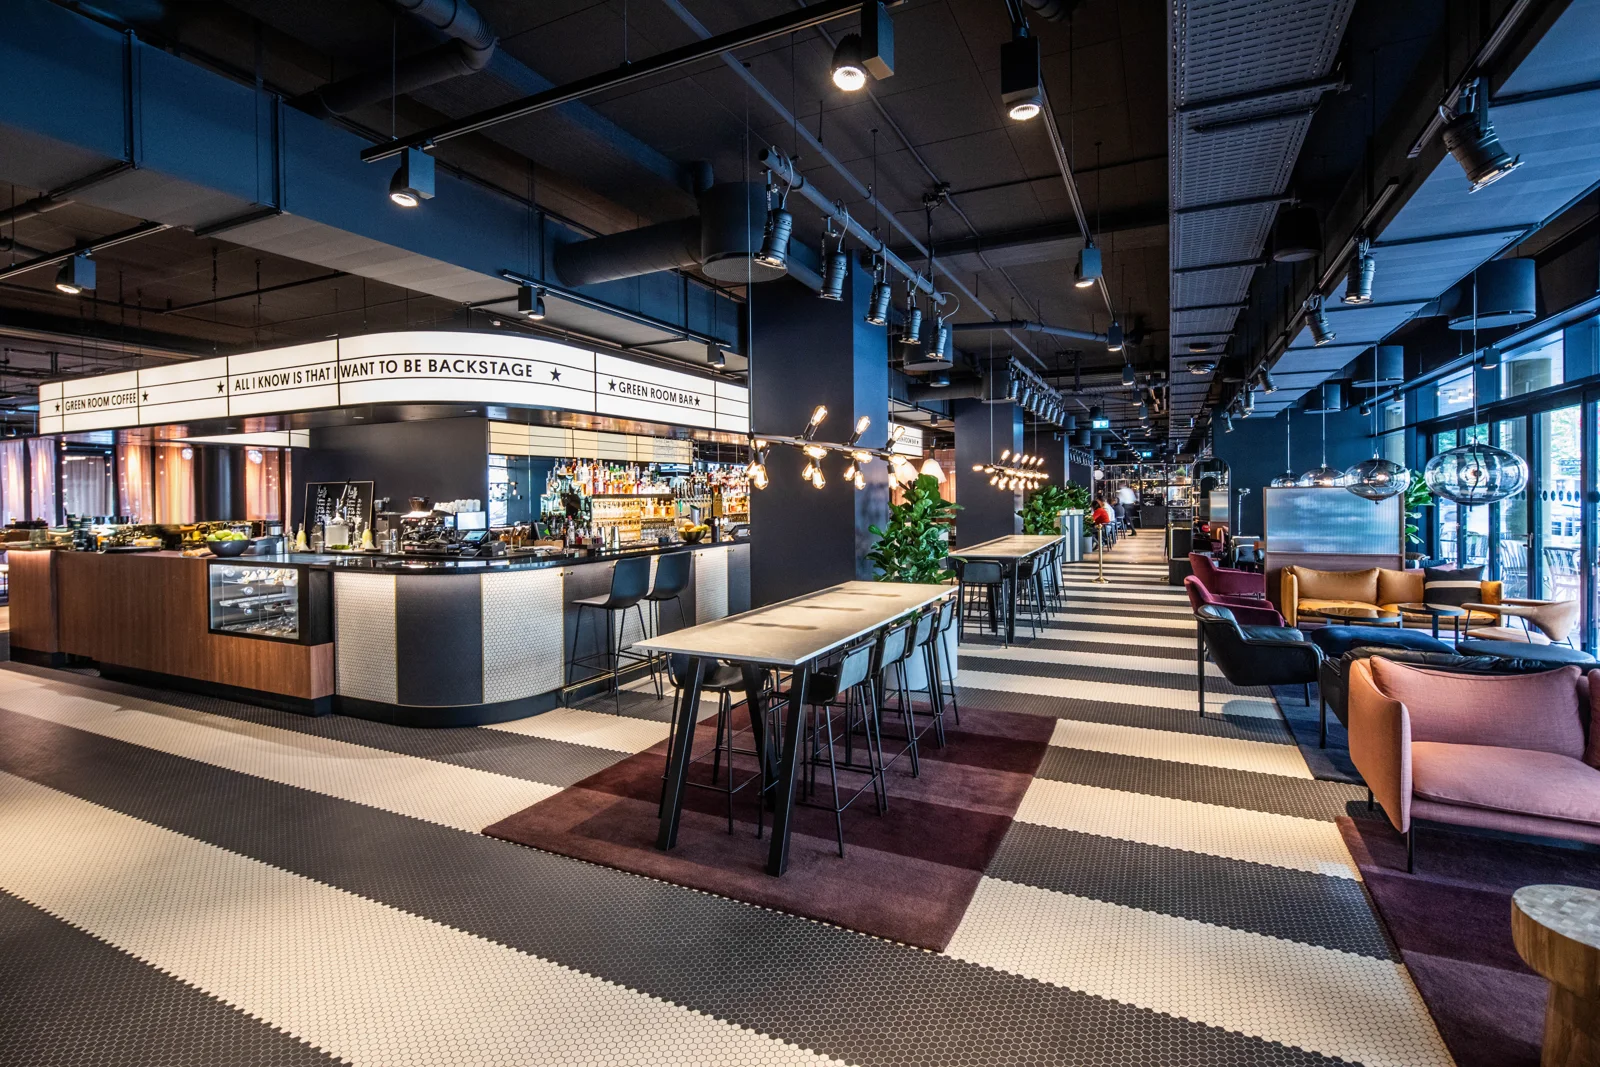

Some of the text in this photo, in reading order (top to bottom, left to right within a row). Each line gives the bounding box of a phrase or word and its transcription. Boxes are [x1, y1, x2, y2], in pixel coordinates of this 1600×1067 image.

[235, 378, 250, 391] ALL
[252, 377, 256, 389] I
[258, 373, 290, 388] KNOW
[293, 371, 302, 384] IS
[305, 367, 330, 382] THAT
[340, 361, 375, 378] WANT
[379, 360, 398, 374] TO
[404, 359, 422, 373] BE
[428, 359, 532, 378] BACKSTAGE
[65, 392, 137, 411] GREEN ROOM COFFEE
[618, 381, 694, 405] GREEN ROOM BAR
